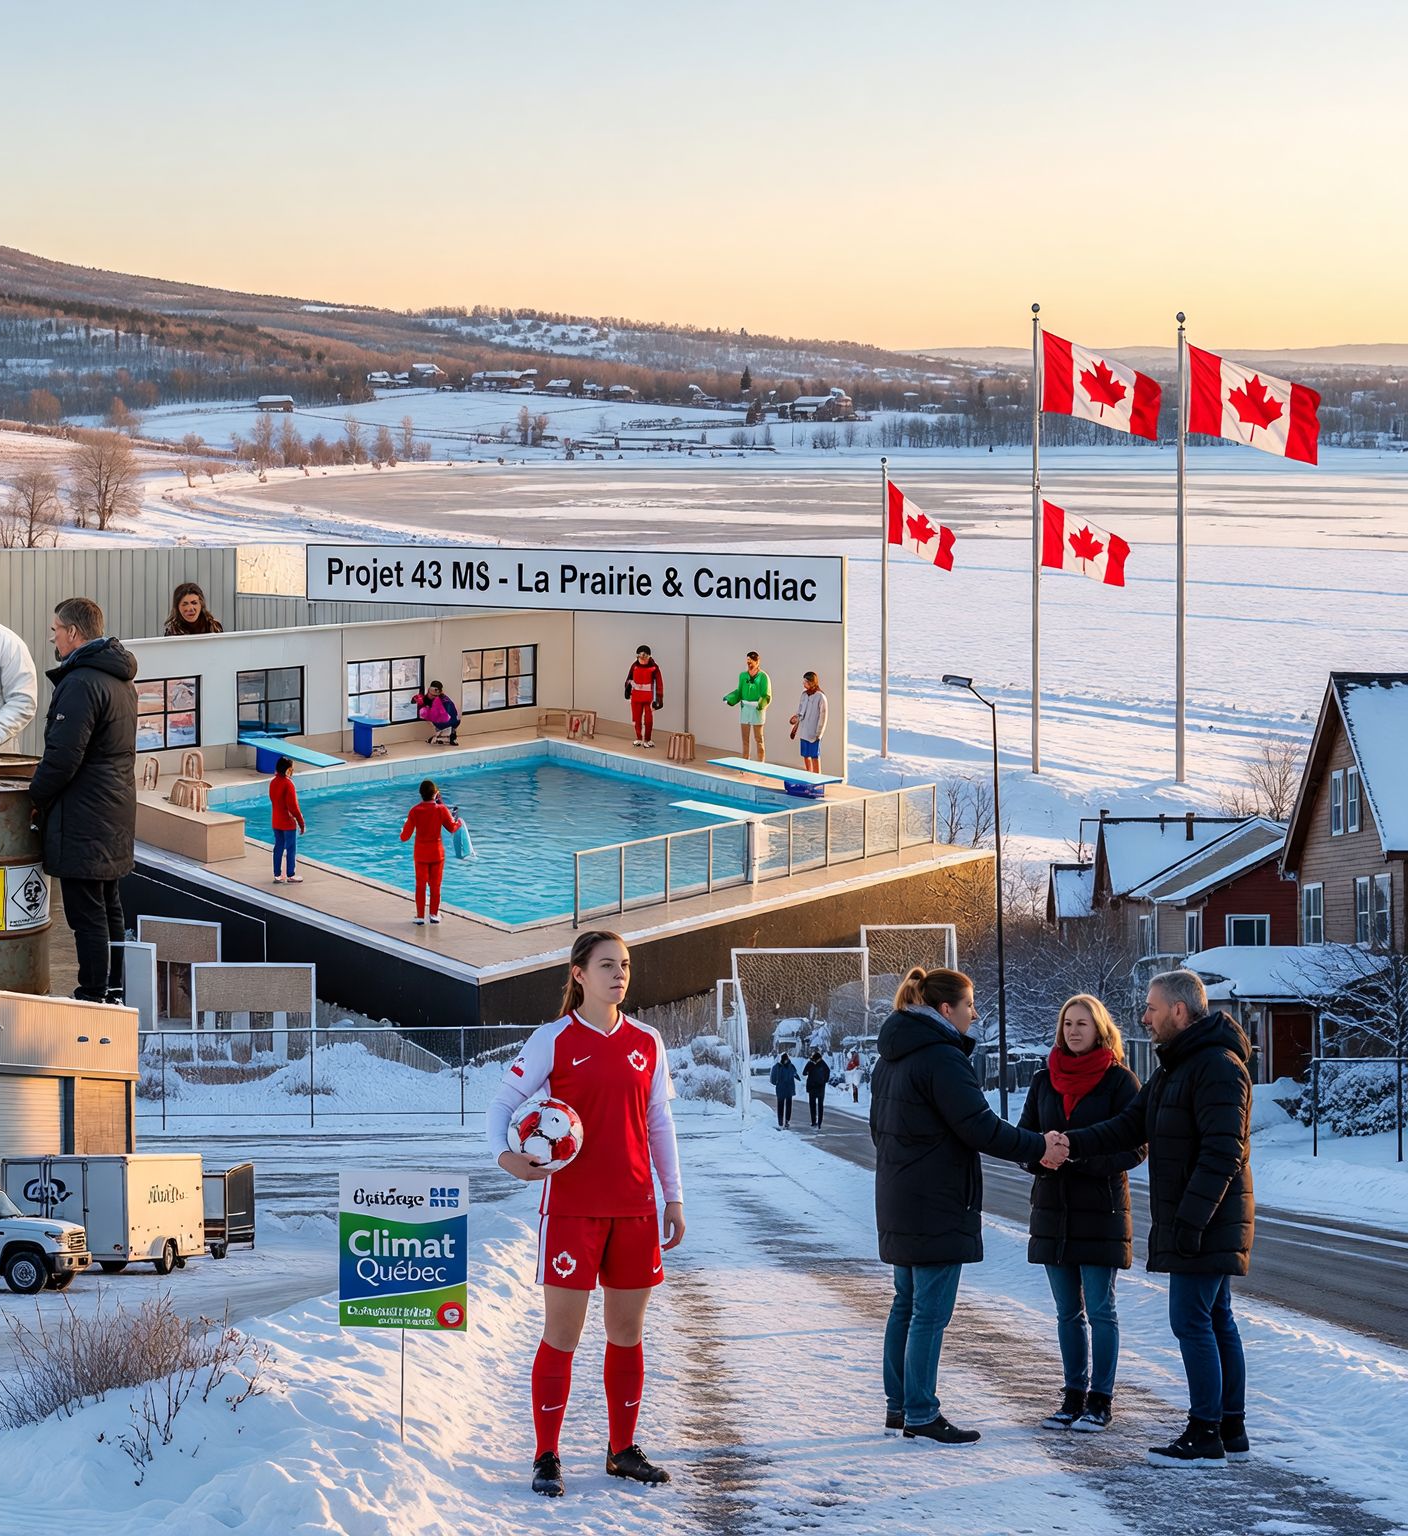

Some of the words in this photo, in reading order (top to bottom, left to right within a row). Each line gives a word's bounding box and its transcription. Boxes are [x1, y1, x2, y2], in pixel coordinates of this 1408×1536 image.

[327, 557, 404, 593] Projet
[411, 560, 442, 589] 43
[452, 560, 490, 592] MS
[498, 576, 508, 584] -
[517, 563, 550, 593] La
[560, 564, 652, 597] Prairie
[661, 566, 684, 597] &
[693, 567, 817, 602] Candiac
[348, 1229, 456, 1259] Climat
[356, 1257, 447, 1287] Québec
